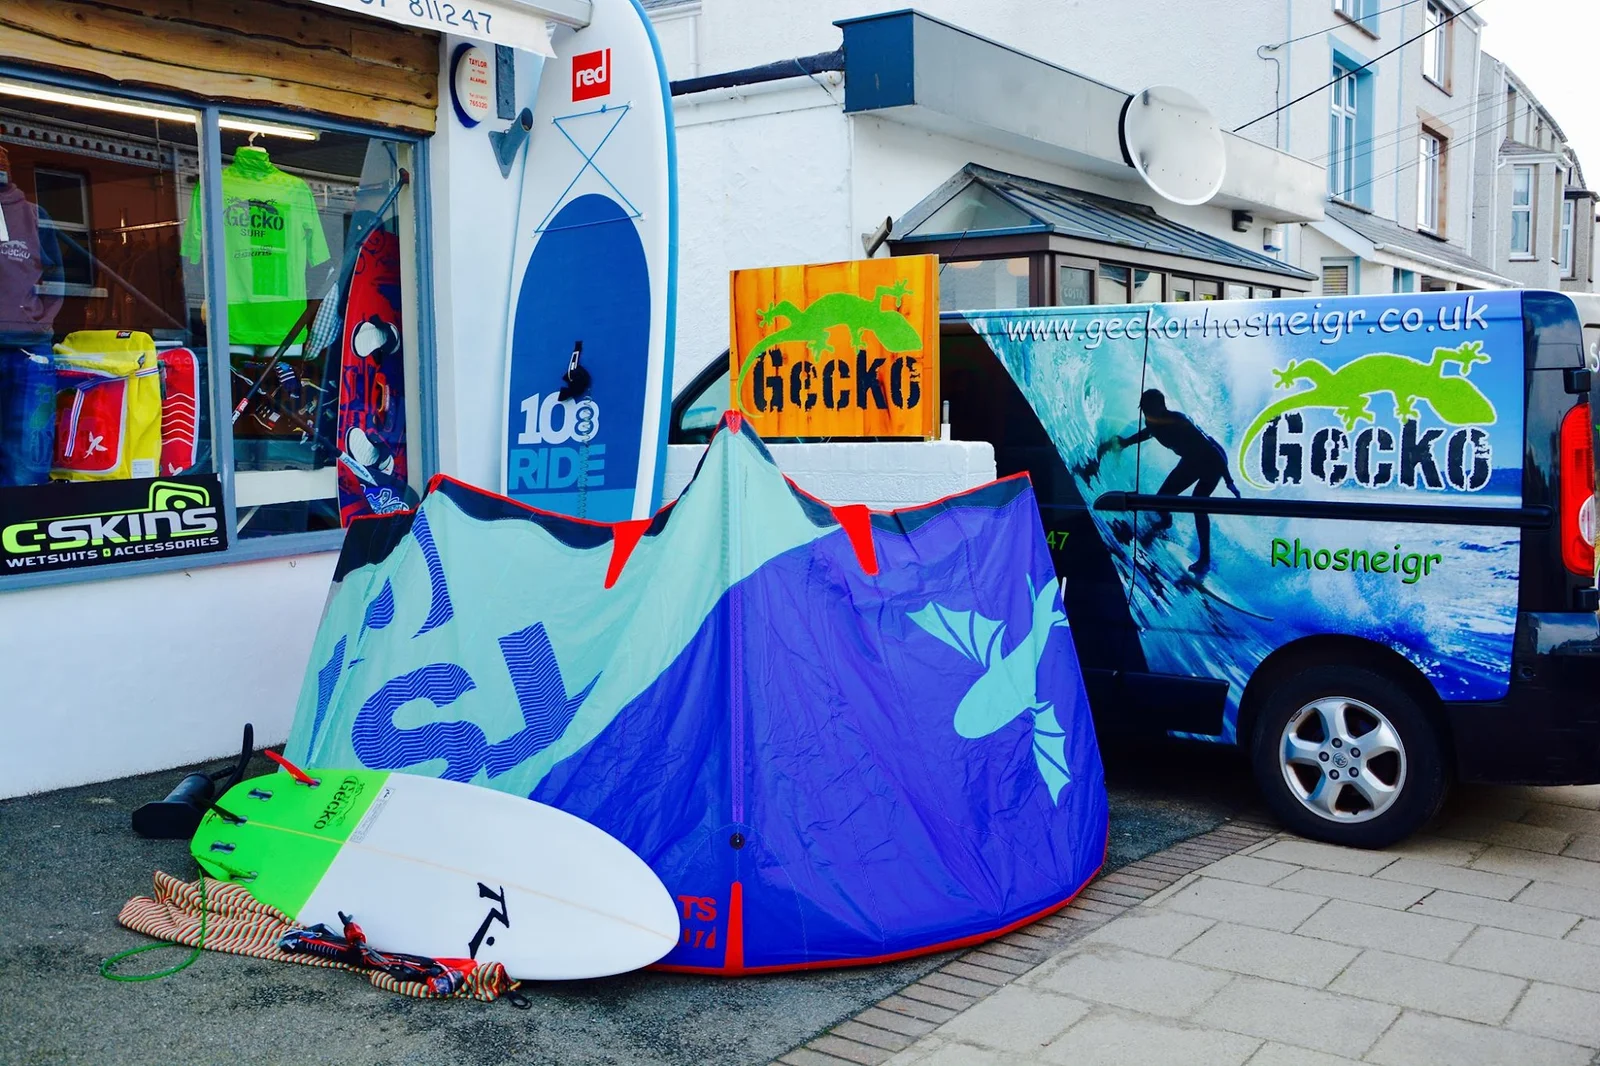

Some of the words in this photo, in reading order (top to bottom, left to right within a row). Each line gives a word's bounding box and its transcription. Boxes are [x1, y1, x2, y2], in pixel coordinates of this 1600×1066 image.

[409, 0, 492, 34] 811247
[468, 58, 488, 68] TAYLOR
[470, 77, 488, 85] ALARMS
[576, 48, 607, 88] red
[240, 229, 266, 238] SURF
[1006, 295, 1490, 350] www.geckorhosneigr.co.uk
[753, 348, 922, 413] Gecko
[508, 444, 606, 490] RIDE
[1261, 412, 1491, 491] Gecko
[6, 550, 98, 568] WETSUITS
[114, 536, 220, 557] ACCESSORIES
[1271, 537, 1443, 585] Rhosneigr
